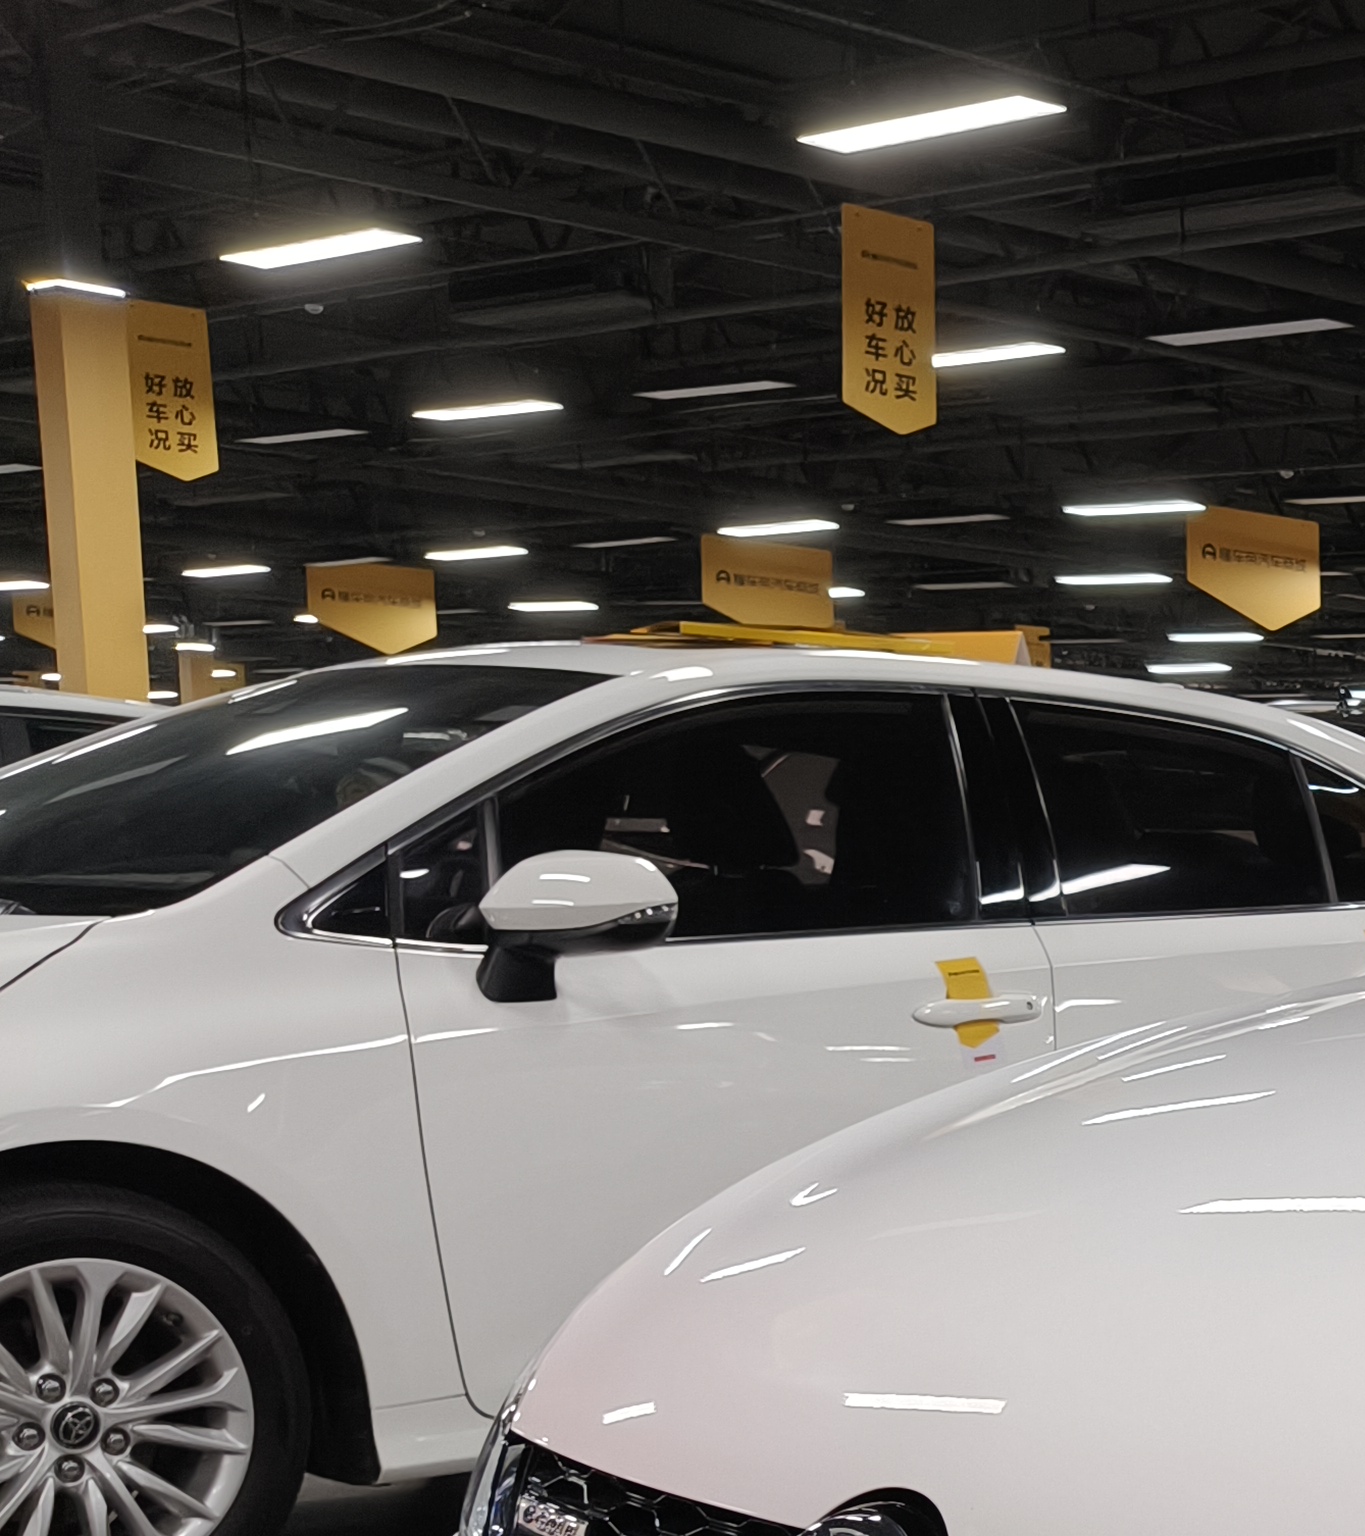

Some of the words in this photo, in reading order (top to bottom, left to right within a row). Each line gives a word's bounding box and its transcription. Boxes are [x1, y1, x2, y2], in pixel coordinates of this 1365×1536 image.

[864, 298, 888, 396] 好车况
[893, 304, 917, 402] 放心买
[144, 371, 171, 451] 好车况
[172, 376, 199, 454] 放心买
